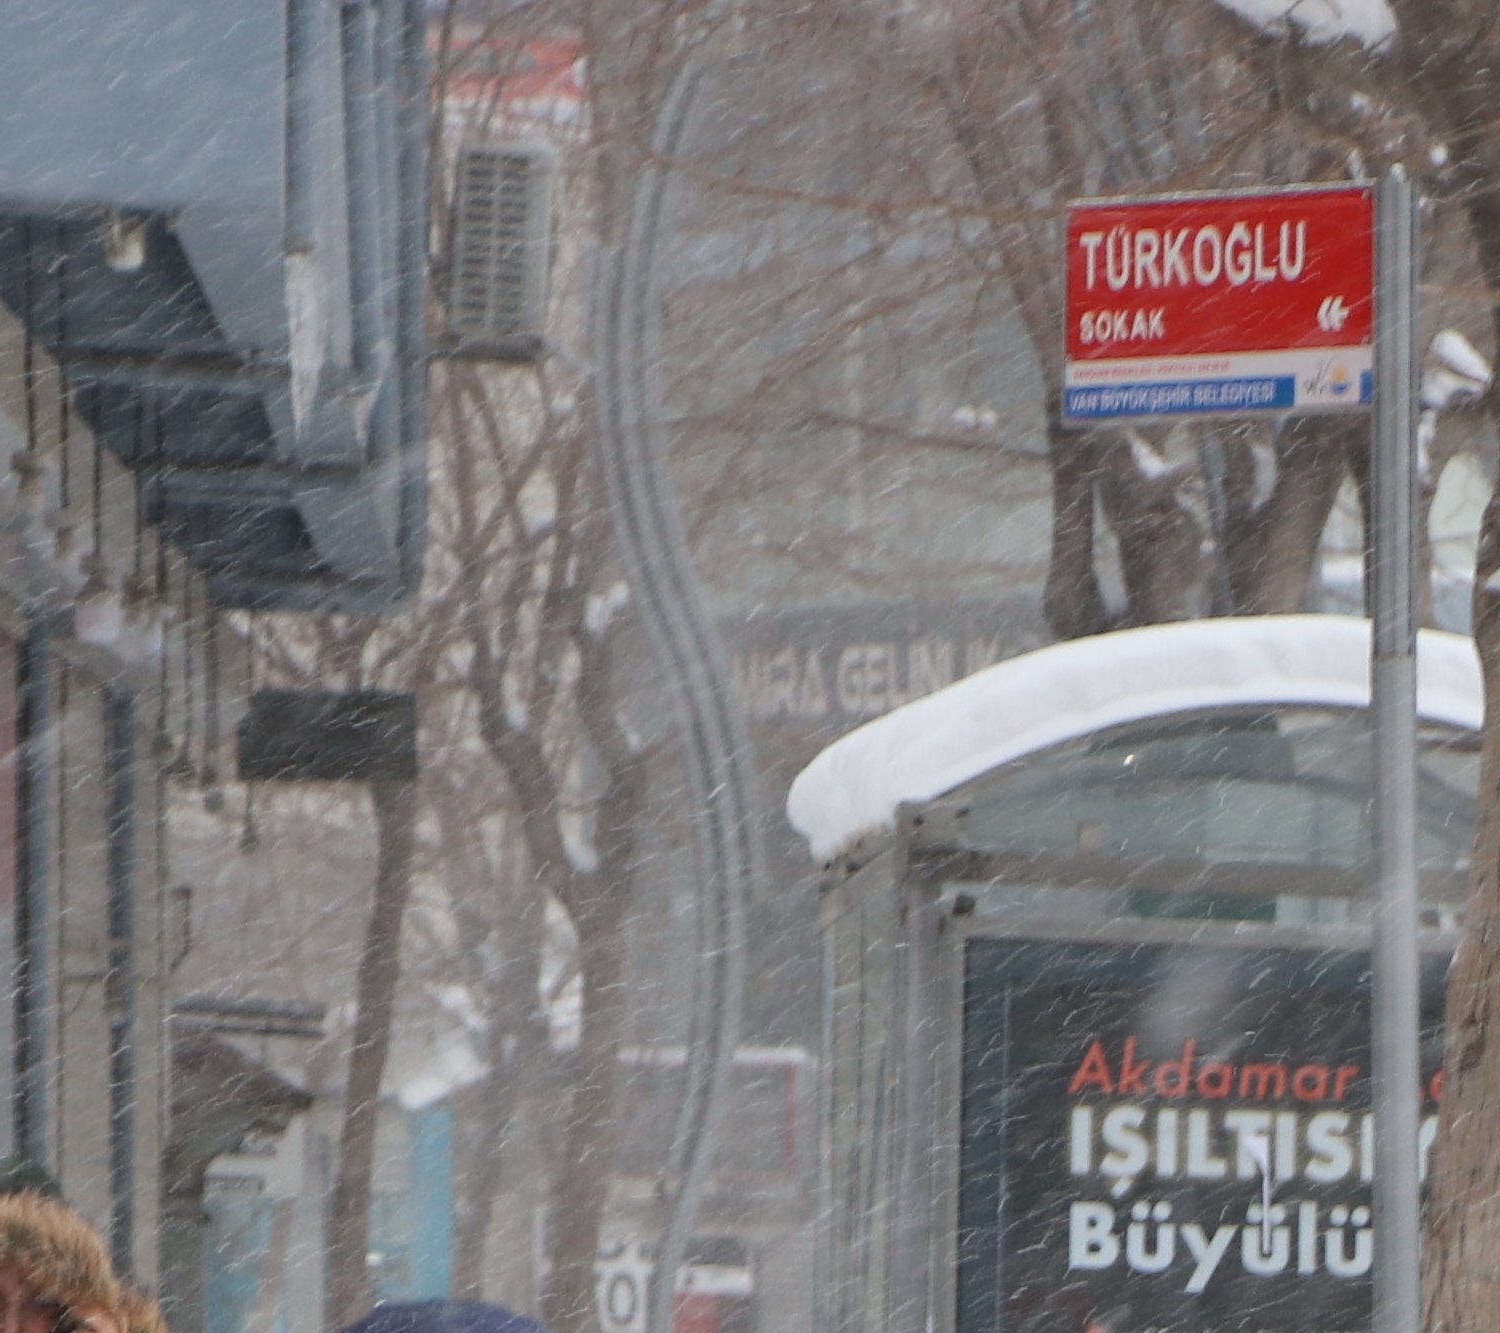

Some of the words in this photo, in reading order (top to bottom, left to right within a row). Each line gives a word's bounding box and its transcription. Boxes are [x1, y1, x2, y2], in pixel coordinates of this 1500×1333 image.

[1079, 219, 1307, 292] TÜRKOĞLU
[1079, 307, 1165, 344] SOKAK
[1070, 387, 1098, 413] VAN
[1068, 1036, 1361, 1101] Akdamar
